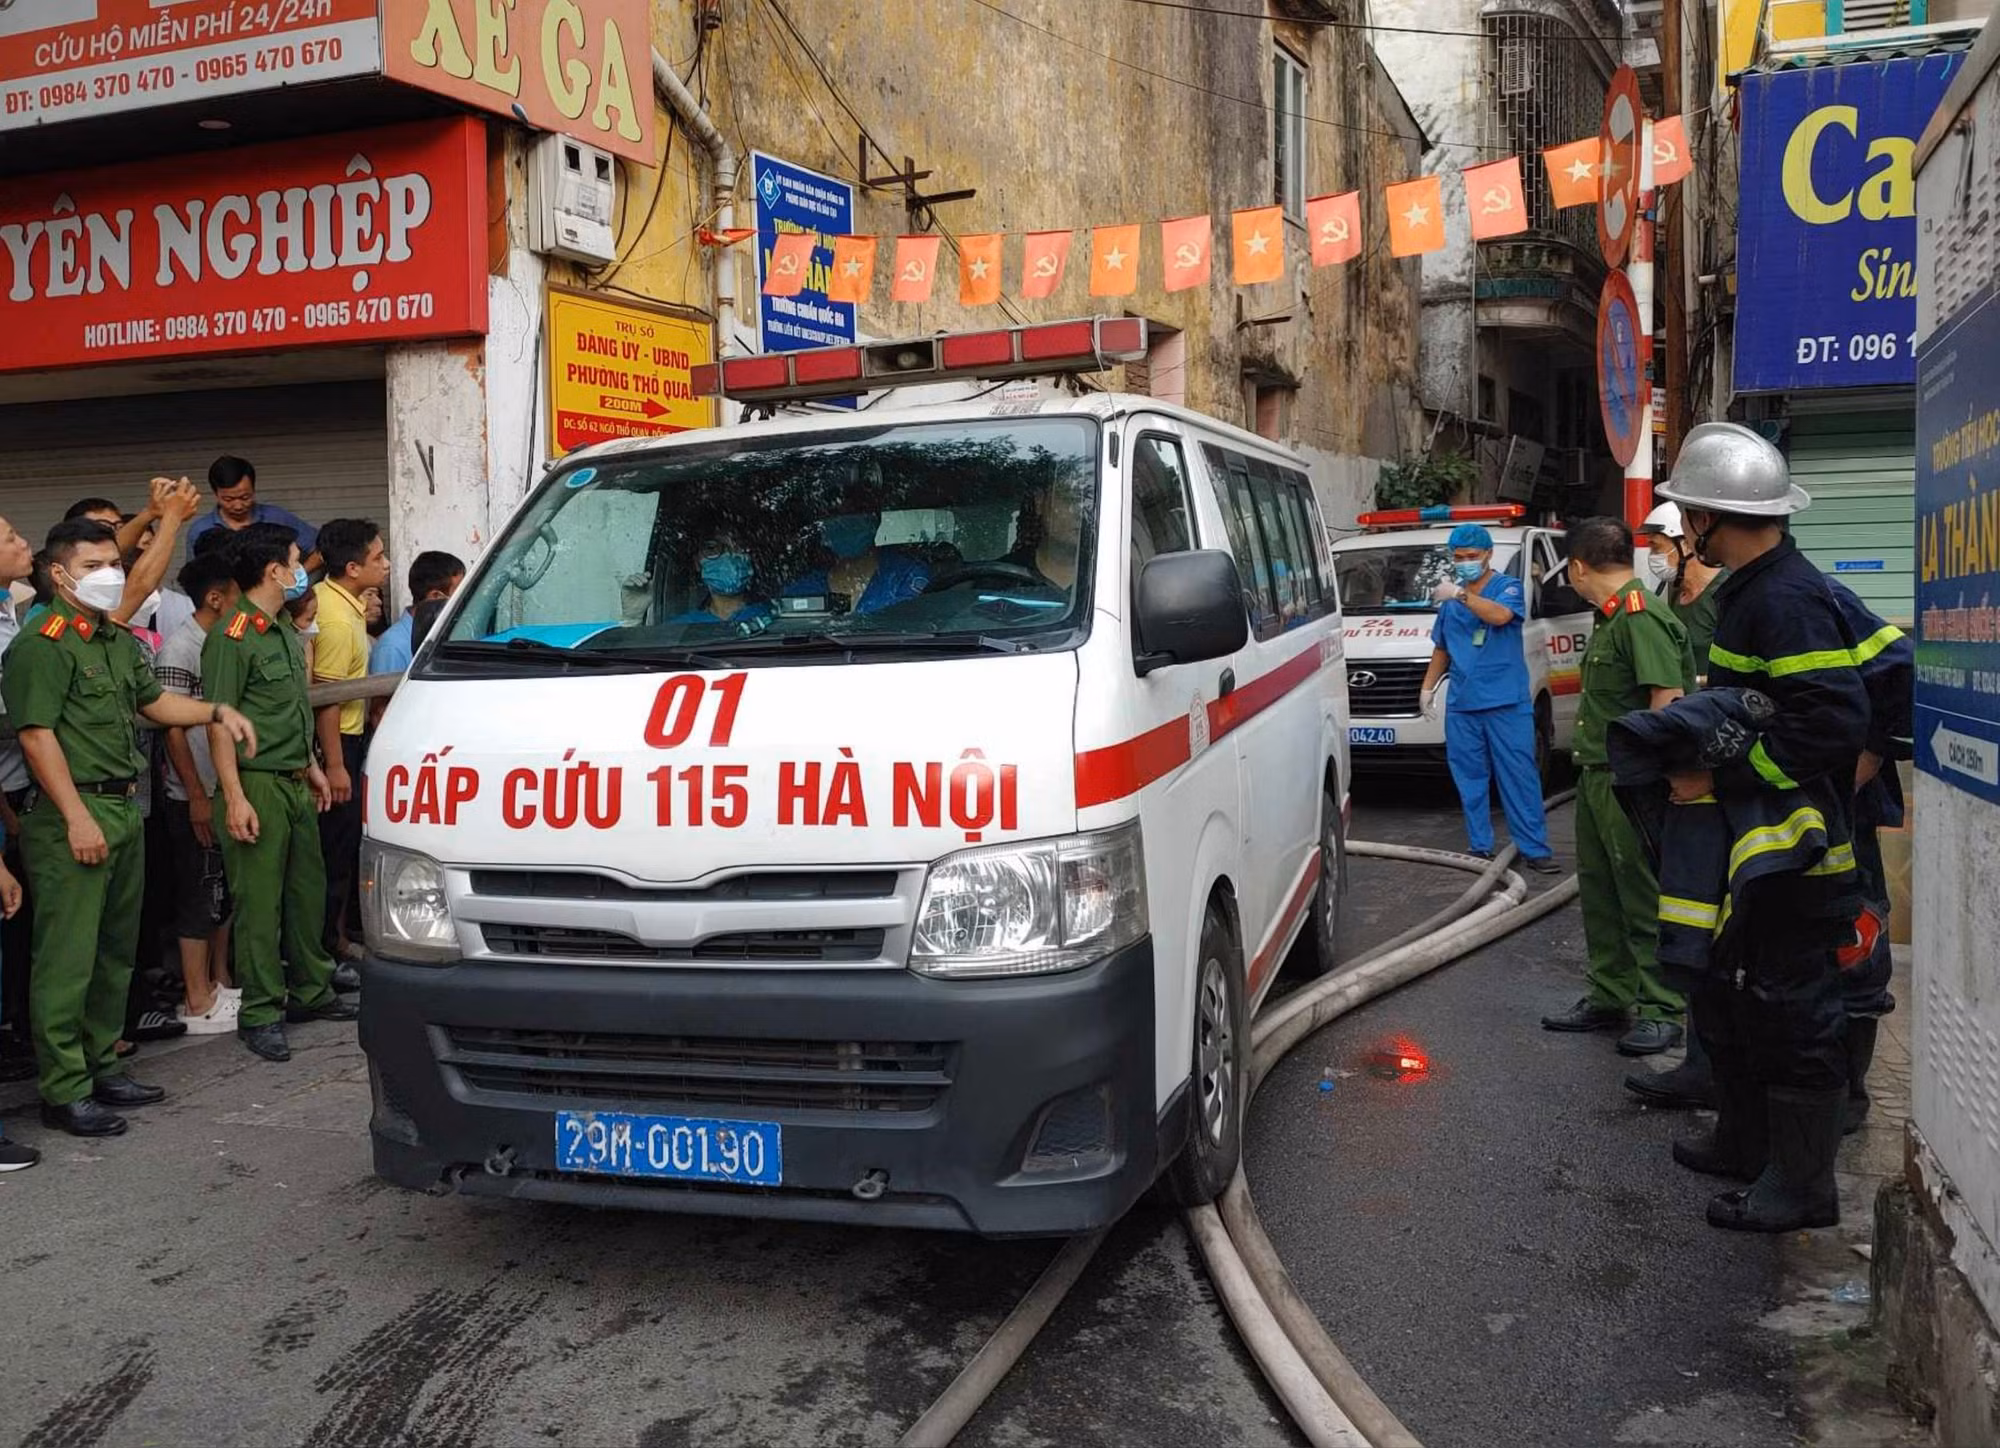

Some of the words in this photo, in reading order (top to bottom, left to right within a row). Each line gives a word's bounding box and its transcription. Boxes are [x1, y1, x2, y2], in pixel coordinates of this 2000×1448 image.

[35, 31, 84, 67] CỨU
[90, 24, 123, 60] HỘ
[130, 9, 188, 50] MIỄN
[194, 1, 235, 39] PHÍ
[6, 91, 33, 114] ĐT:
[39, 82, 87, 108] 0984
[94, 73, 130, 99] 370
[137, 66, 174, 92] 470
[196, 54, 248, 82] 0965
[255, 46, 294, 72] 470
[301, 38, 342, 65] 670
[541, 0, 641, 142] GA
[153, 153, 431, 292] NGHIỆP
[84, 320, 160, 348] HOTLINE:
[165, 315, 208, 341] 0984
[213, 310, 247, 335] 370
[251, 306, 286, 332] 470
[304, 302, 350, 329] 0965
[356, 298, 391, 323] 470
[397, 293, 433, 318] 670
[615, 320, 637, 336] TRỤ
[1797, 336, 1839, 363] ĐT:
[1849, 332, 1897, 362] 096
[576, 328, 618, 358] ĐẢNG
[653, 347, 690, 371] UBND
[567, 362, 629, 391] PHƯỜNG
[633, 370, 659, 395] THỔ
[604, 397, 642, 412] 200M
[589, 421, 598, 432] 62
[1921, 511, 1939, 583] LA
[1944, 470, 2000, 579] THÀN
[1361, 619, 1394, 628] 24
[1366, 628, 1393, 638] 115
[643, 672, 748, 749] 01
[385, 745, 479, 826] CẤP
[502, 748, 622, 829] CỨU
[647, 765, 748, 828] 115
[777, 747, 868, 827] HÀ
[892, 748, 1018, 843] NỘI
[565, 1119, 764, 1177] 29M-001.90
